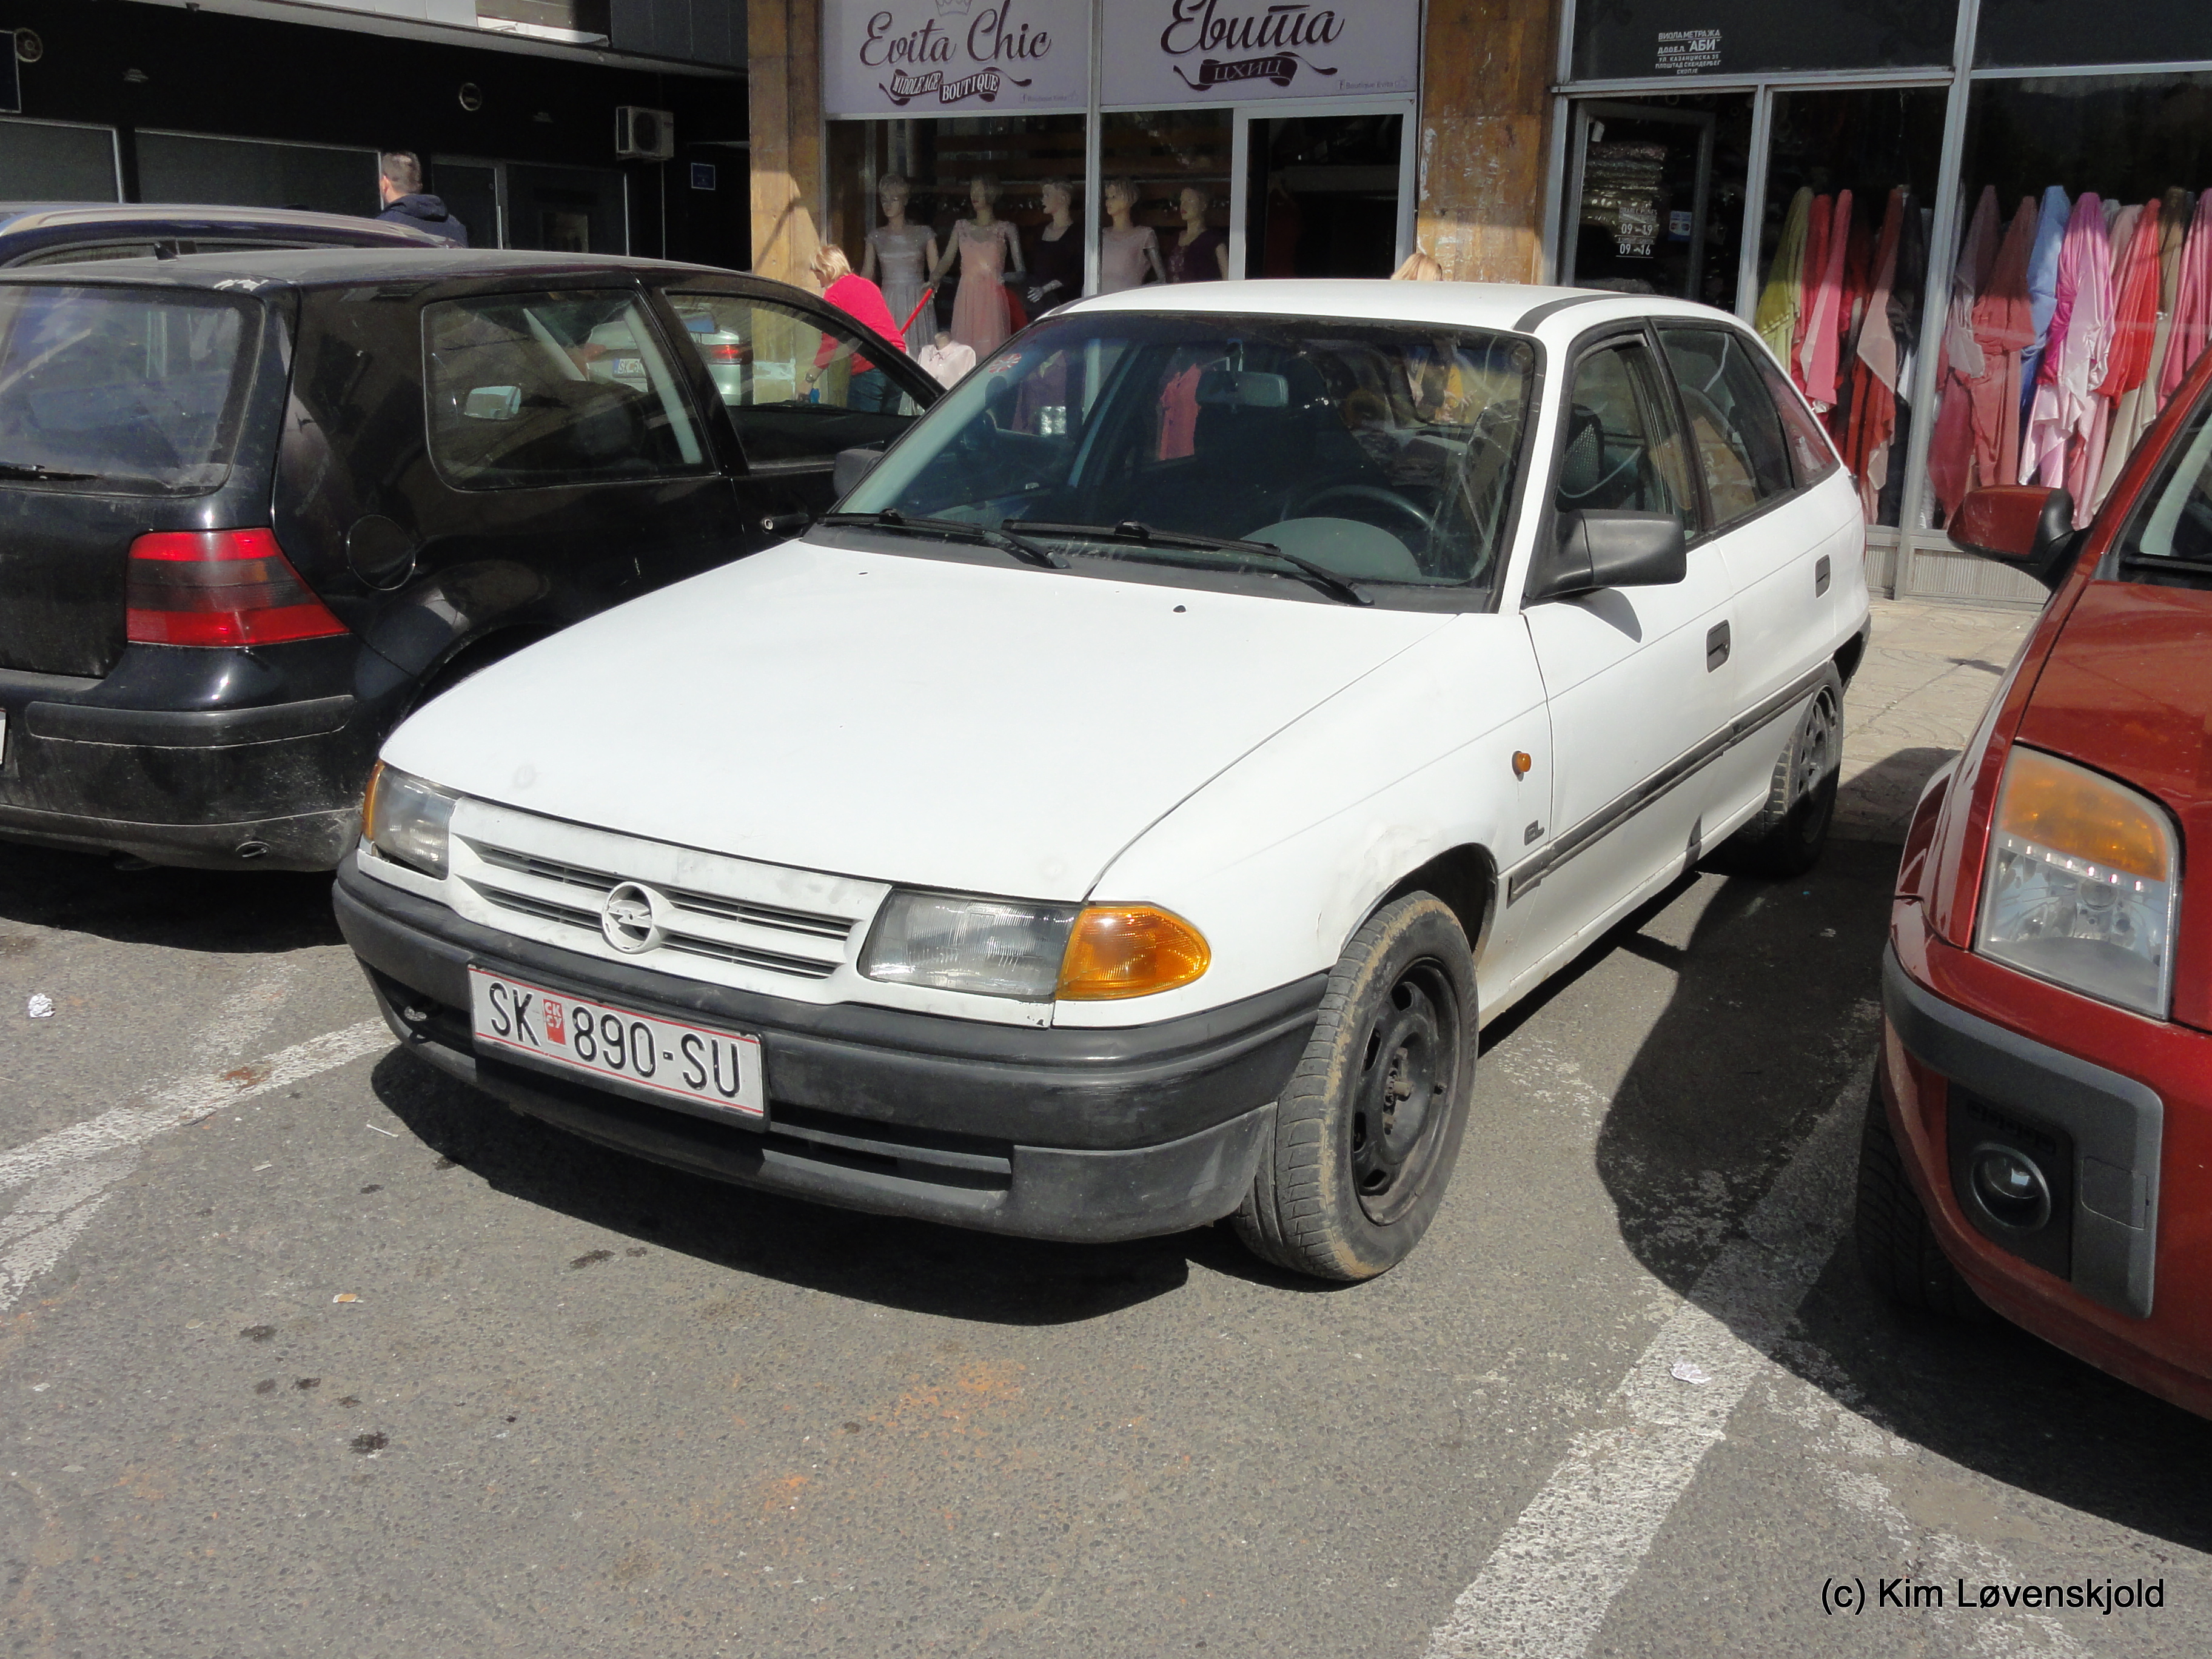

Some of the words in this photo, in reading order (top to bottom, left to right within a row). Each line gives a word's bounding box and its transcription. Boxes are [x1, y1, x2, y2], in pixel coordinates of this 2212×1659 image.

[860, 11, 956, 66] Evita
[967, 0, 1052, 61] Chic
[1683, 30, 1720, 38] МЕТРАЖА
[1213, 59, 1281, 81] ЦХИЦ
[893, 75, 922, 95] MIDDLE
[922, 73, 942, 92] AGE
[942, 73, 998, 101] BOUTIQUE
[1621, 224, 1632, 234] 09
[1643, 224, 1652, 235] 19
[1620, 243, 1631, 254] 09
[1641, 244, 1651, 255] 16
[489, 982, 541, 1047] SK
[572, 1005, 741, 1098] 890-SU
